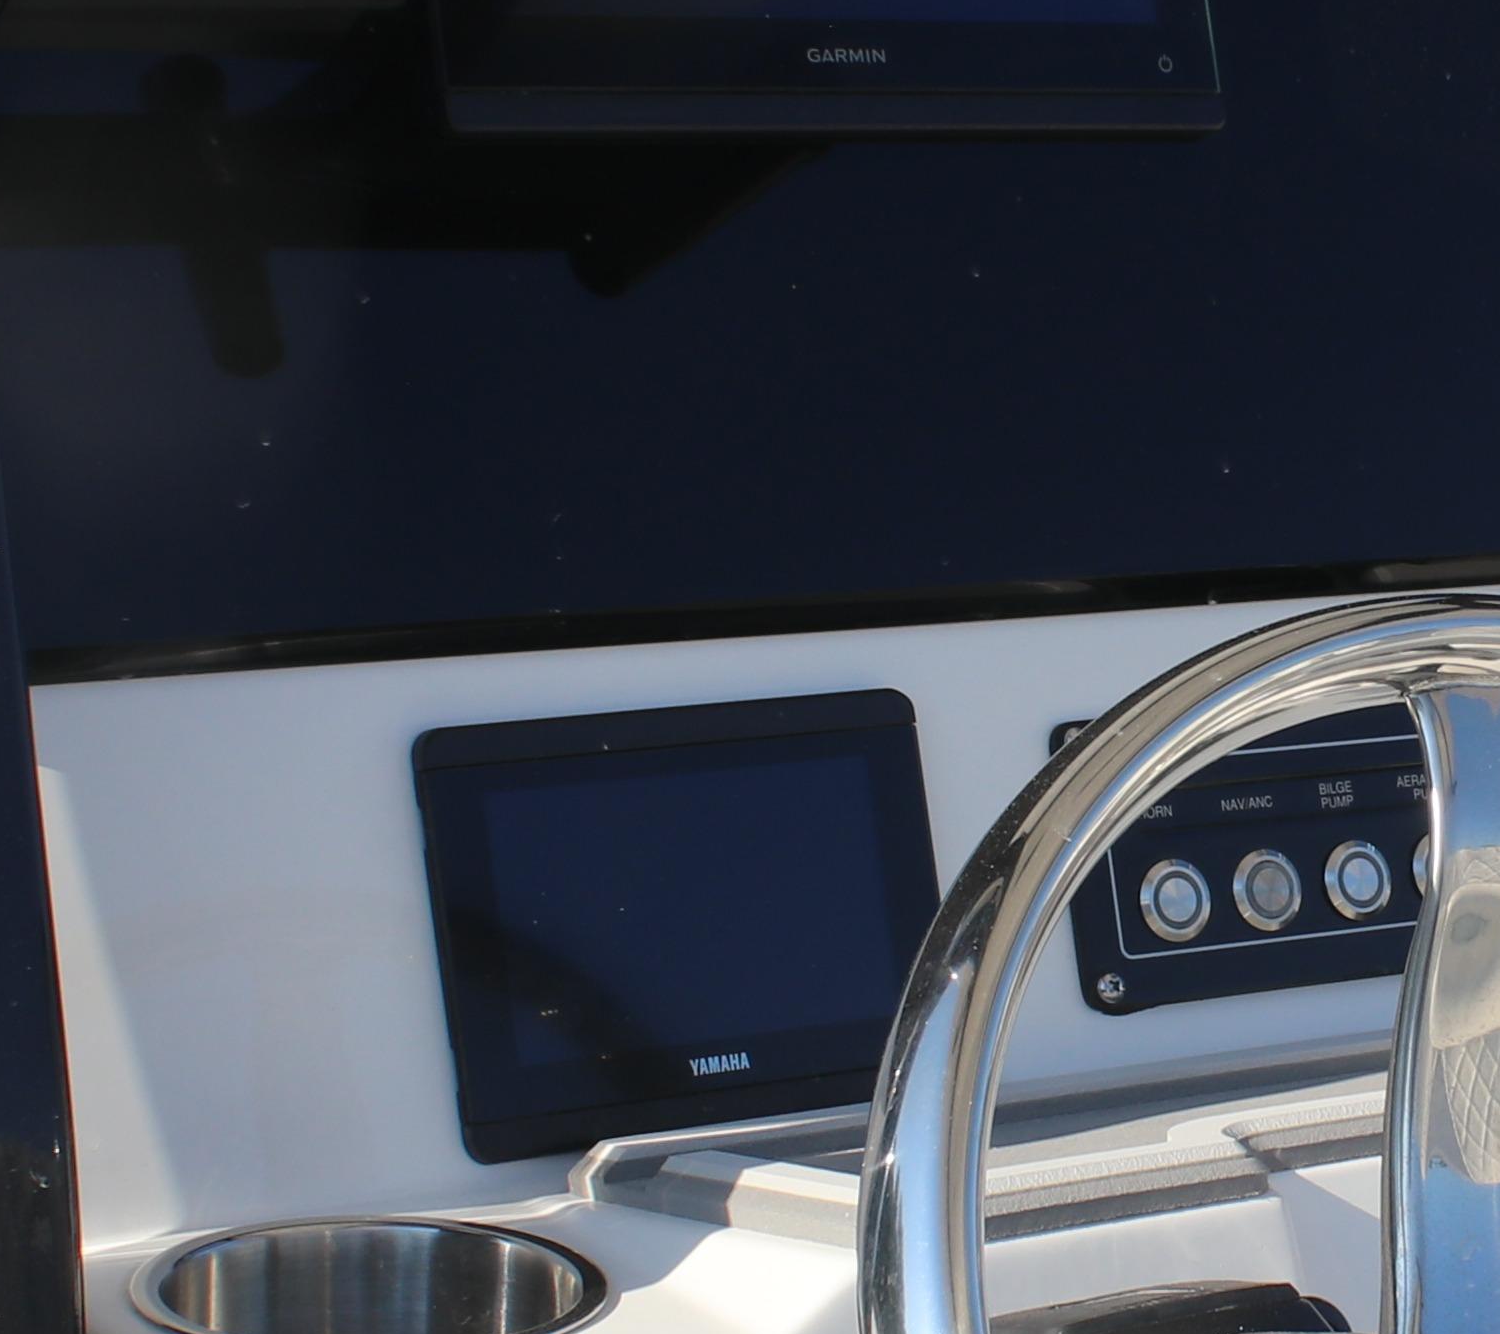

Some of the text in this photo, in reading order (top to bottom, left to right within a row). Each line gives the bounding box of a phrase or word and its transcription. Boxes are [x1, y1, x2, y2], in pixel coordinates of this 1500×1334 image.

[807, 48, 886, 63] GARMIN
[1319, 780, 1353, 796] BILGE
[1396, 774, 1427, 788] AERA
[1321, 794, 1354, 809] PUMP
[1413, 787, 1429, 801] PU
[1220, 795, 1274, 812] NAV/ANC
[689, 1051, 751, 1077] YAMAHA
